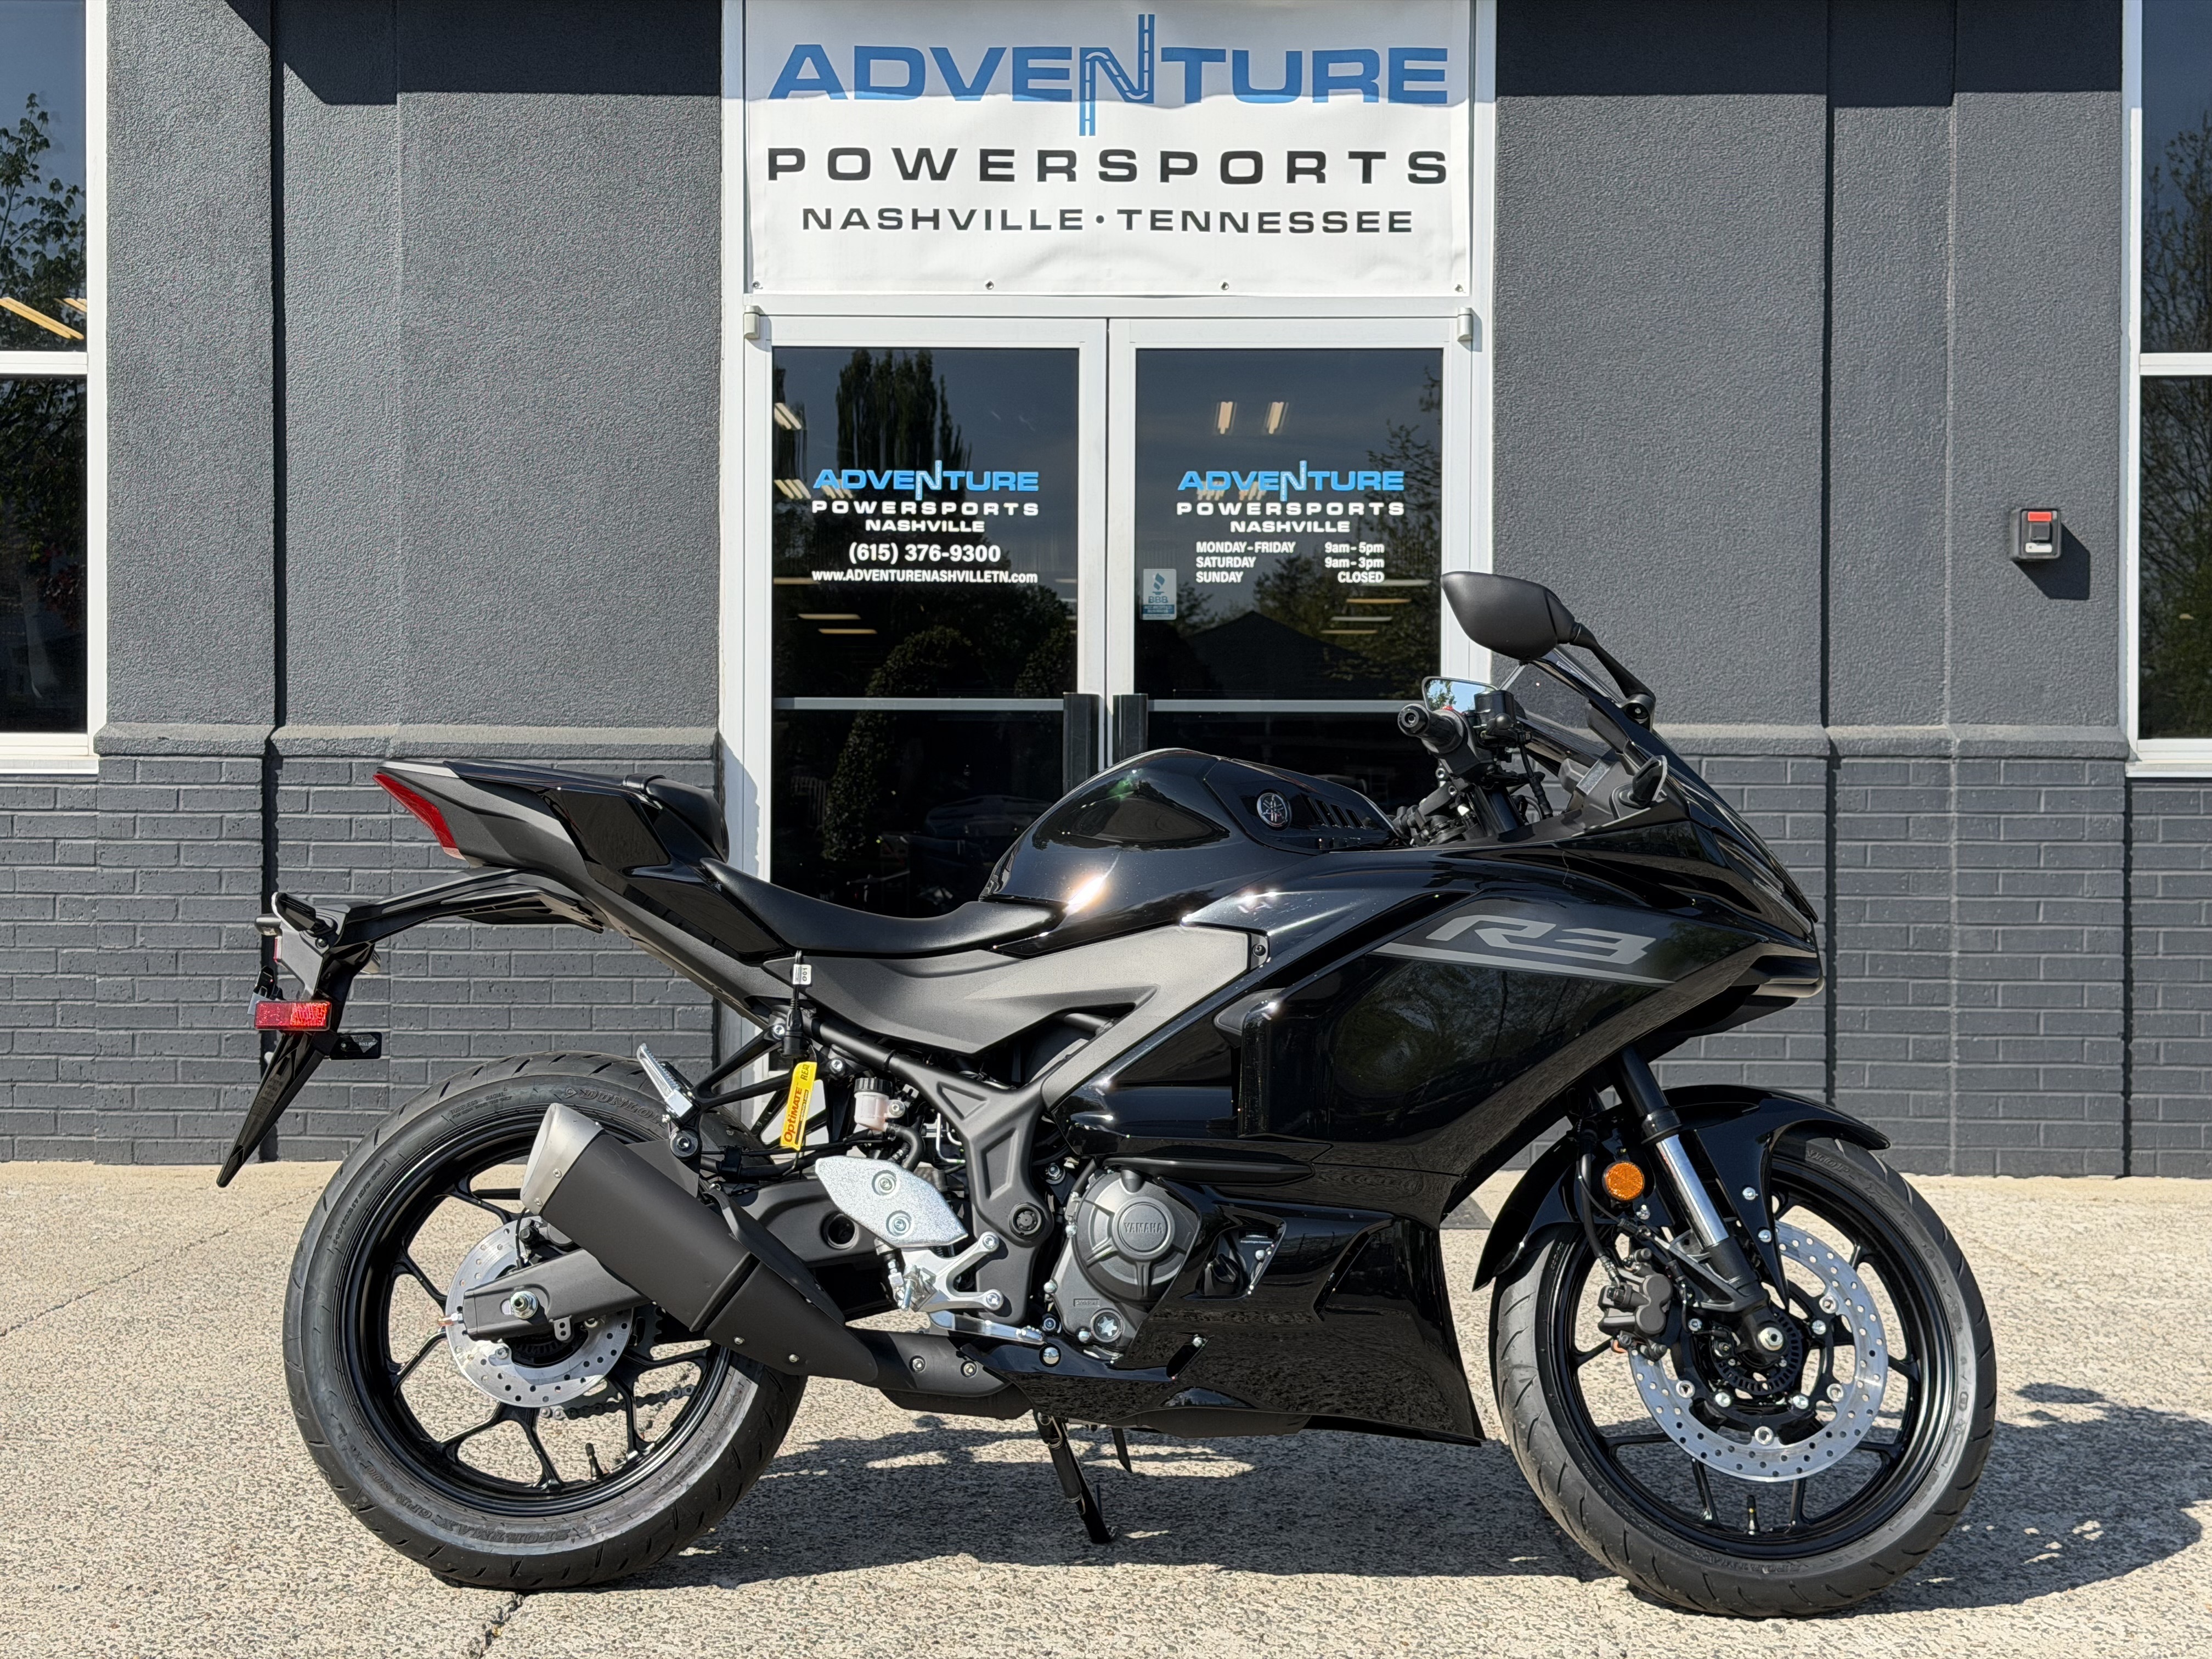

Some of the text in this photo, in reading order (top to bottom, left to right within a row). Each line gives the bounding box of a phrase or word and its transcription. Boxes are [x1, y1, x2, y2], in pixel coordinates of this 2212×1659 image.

[769, 14, 1448, 136] ADVENTURE
[769, 148, 1446, 184] POWERSPORTS
[804, 208, 1411, 233] NASHVILLE TENNESSEE
[813, 460, 1039, 500] ADVENTURE
[1178, 460, 1404, 501] ADVENTURE
[812, 500, 1038, 515] POWERSPORTS
[1177, 503, 1404, 515] POWERSPORTS
[866, 520, 984, 532] NASHVILLE
[1231, 521, 1350, 532] NASHVILLE
[850, 543, 1001, 564] (615) 376-9300
[1197, 556, 1256, 567] SATURDAY
[812, 569, 1037, 583] www.ADVENTURENASHVILLETN.com
[1197, 571, 1384, 583] SUNDAY CLOSED
[1426, 915, 1656, 964] R3
[485, 1092, 505, 1101] RADIAL
[1124, 1222, 1165, 1234] YAMAHA
